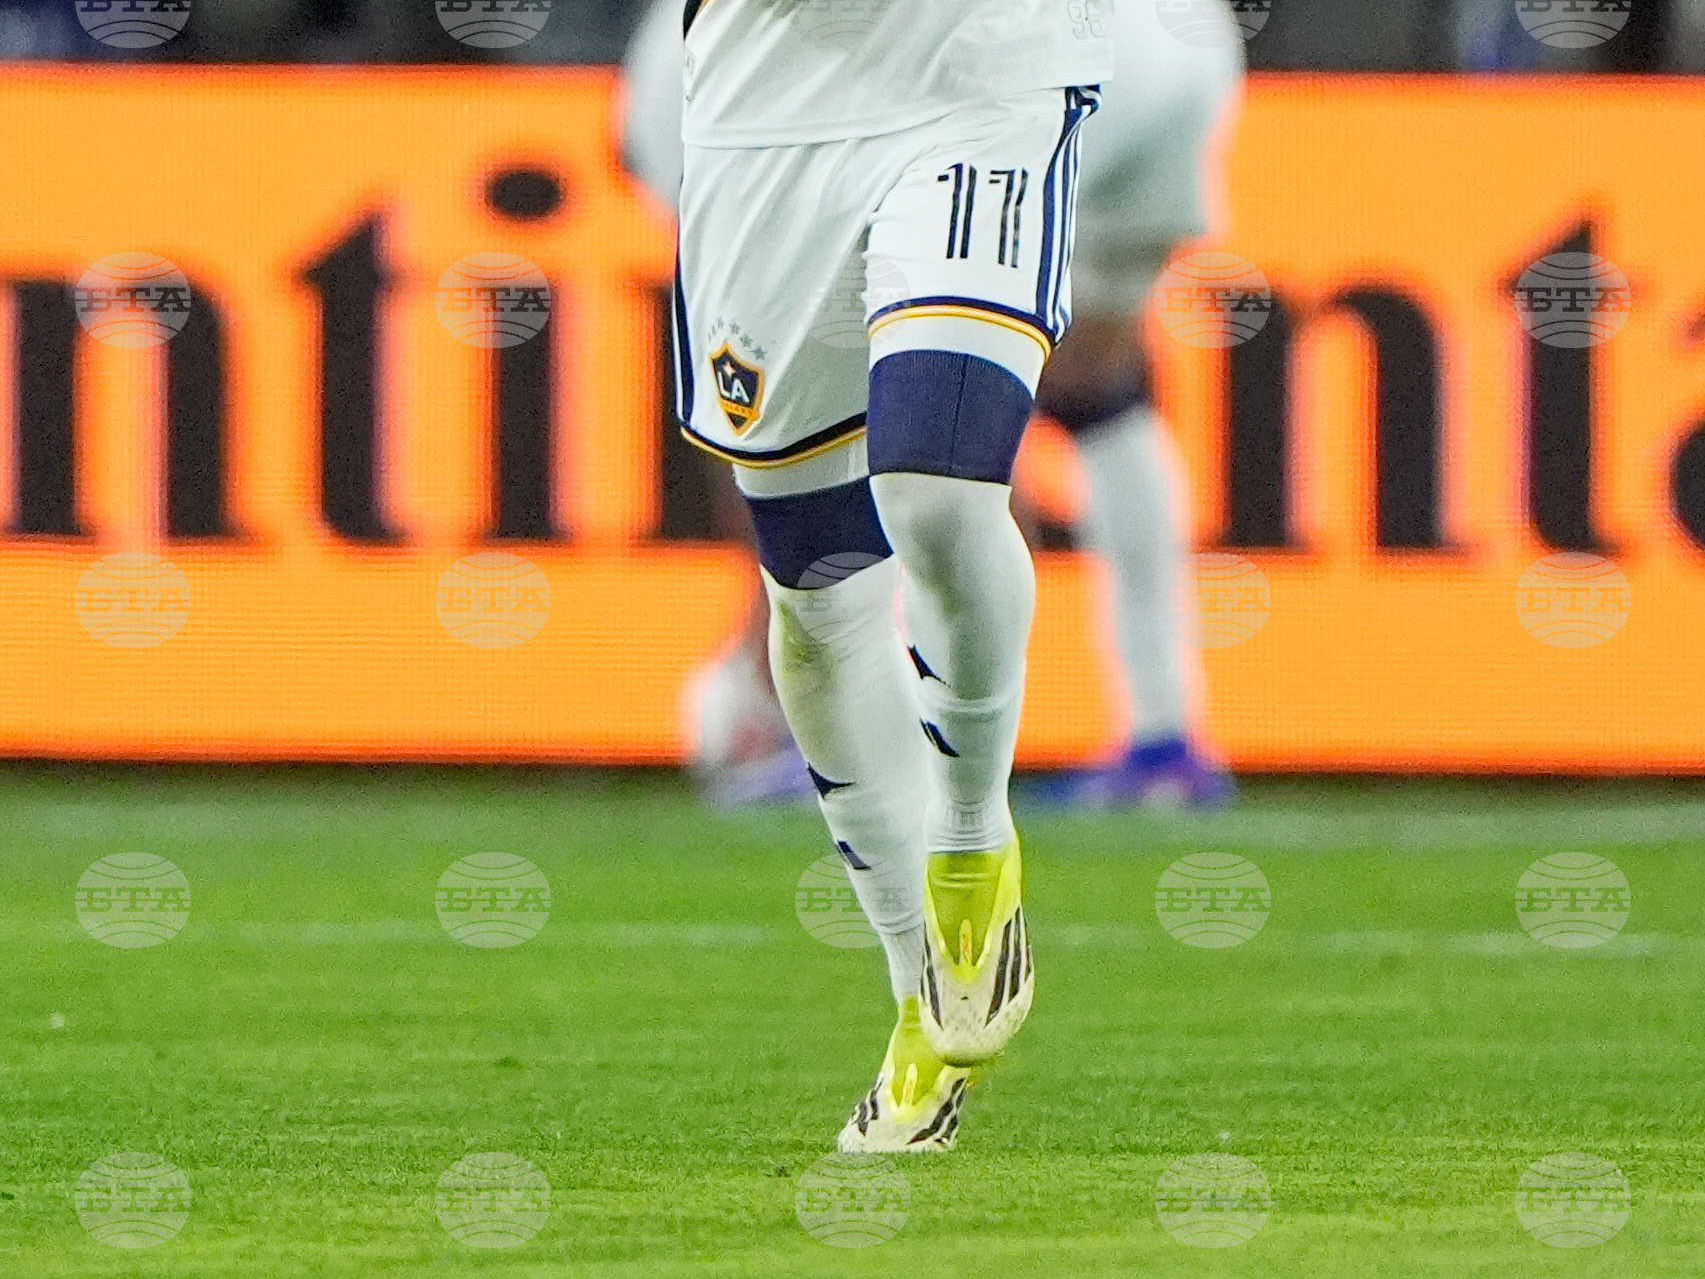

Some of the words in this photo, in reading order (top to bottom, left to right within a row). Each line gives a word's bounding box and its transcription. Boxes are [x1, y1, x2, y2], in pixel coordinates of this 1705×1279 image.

[937, 163, 1028, 268] 11
[0, 166, 1705, 555] ntint
[717, 371, 750, 403] LA
